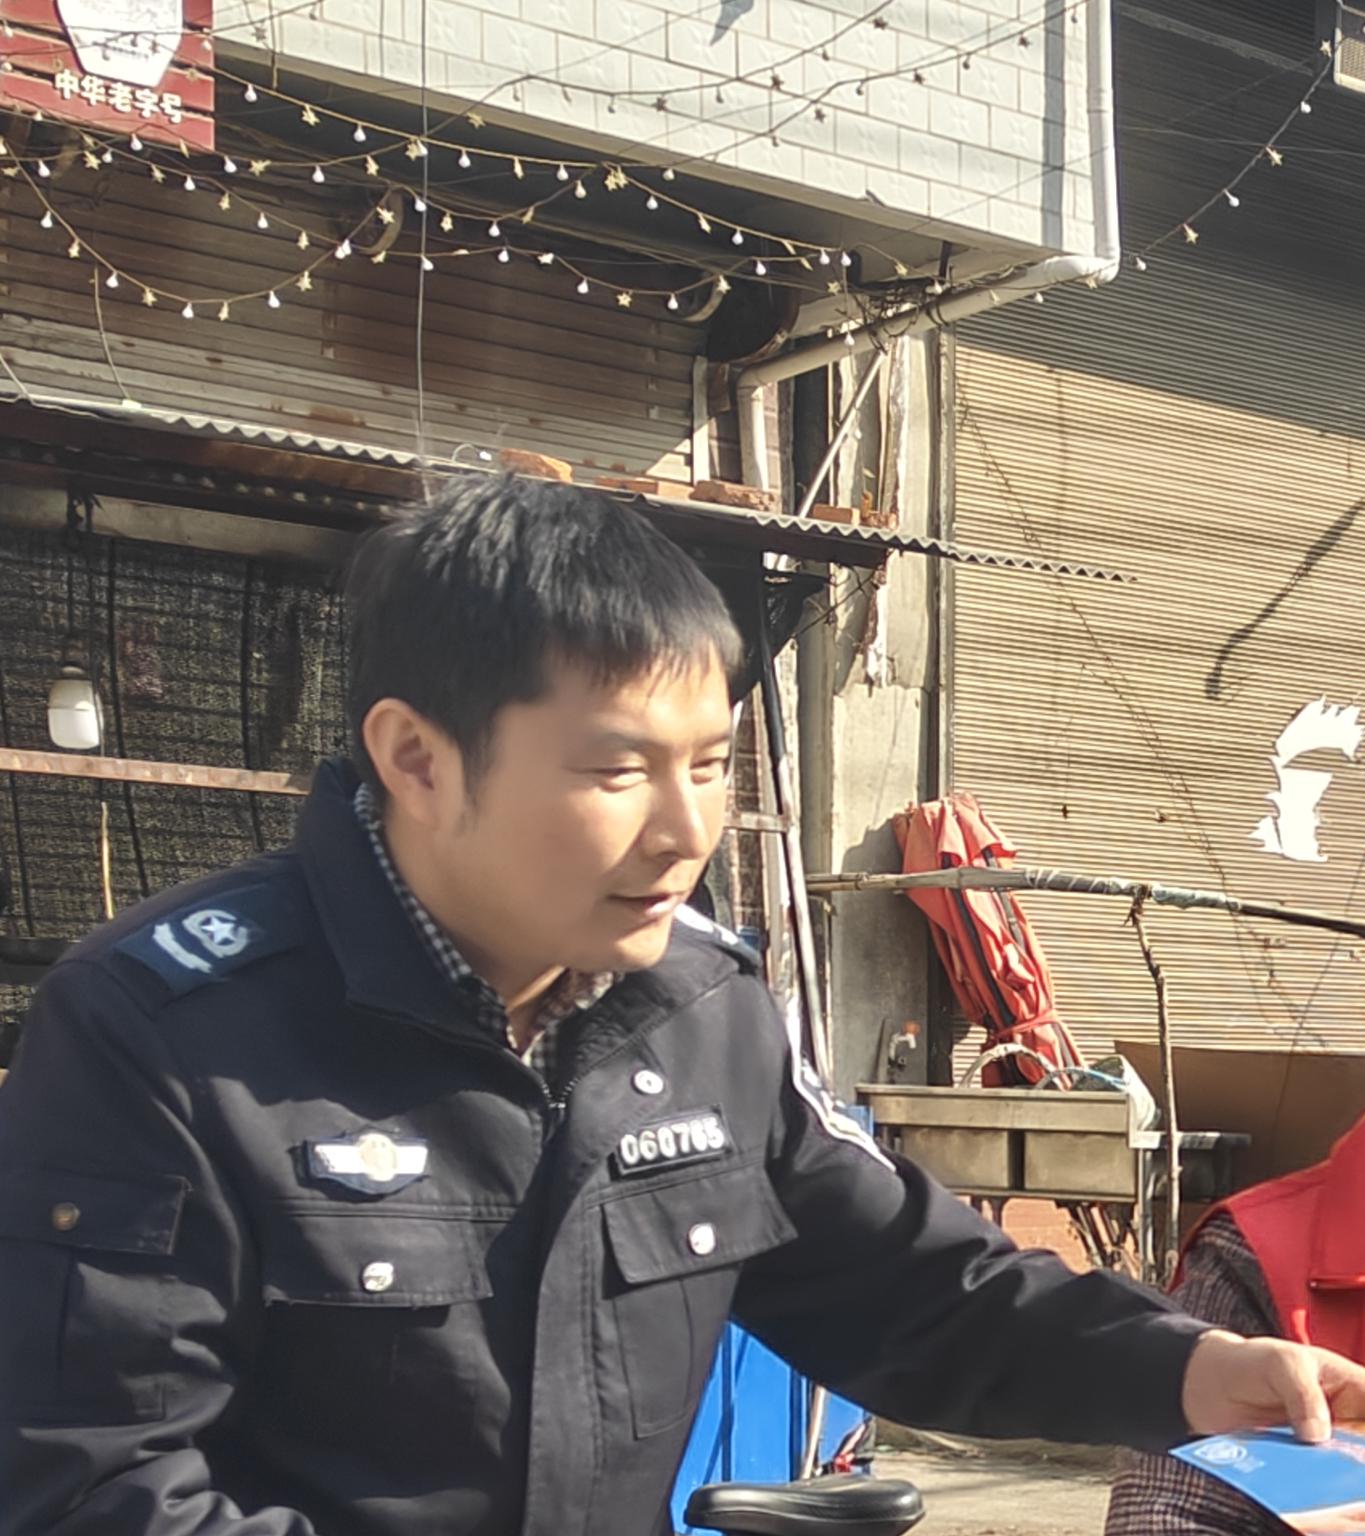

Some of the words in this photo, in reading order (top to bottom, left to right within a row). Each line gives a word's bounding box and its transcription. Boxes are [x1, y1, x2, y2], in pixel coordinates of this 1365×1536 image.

[54, 68, 182, 123] 中华老字号
